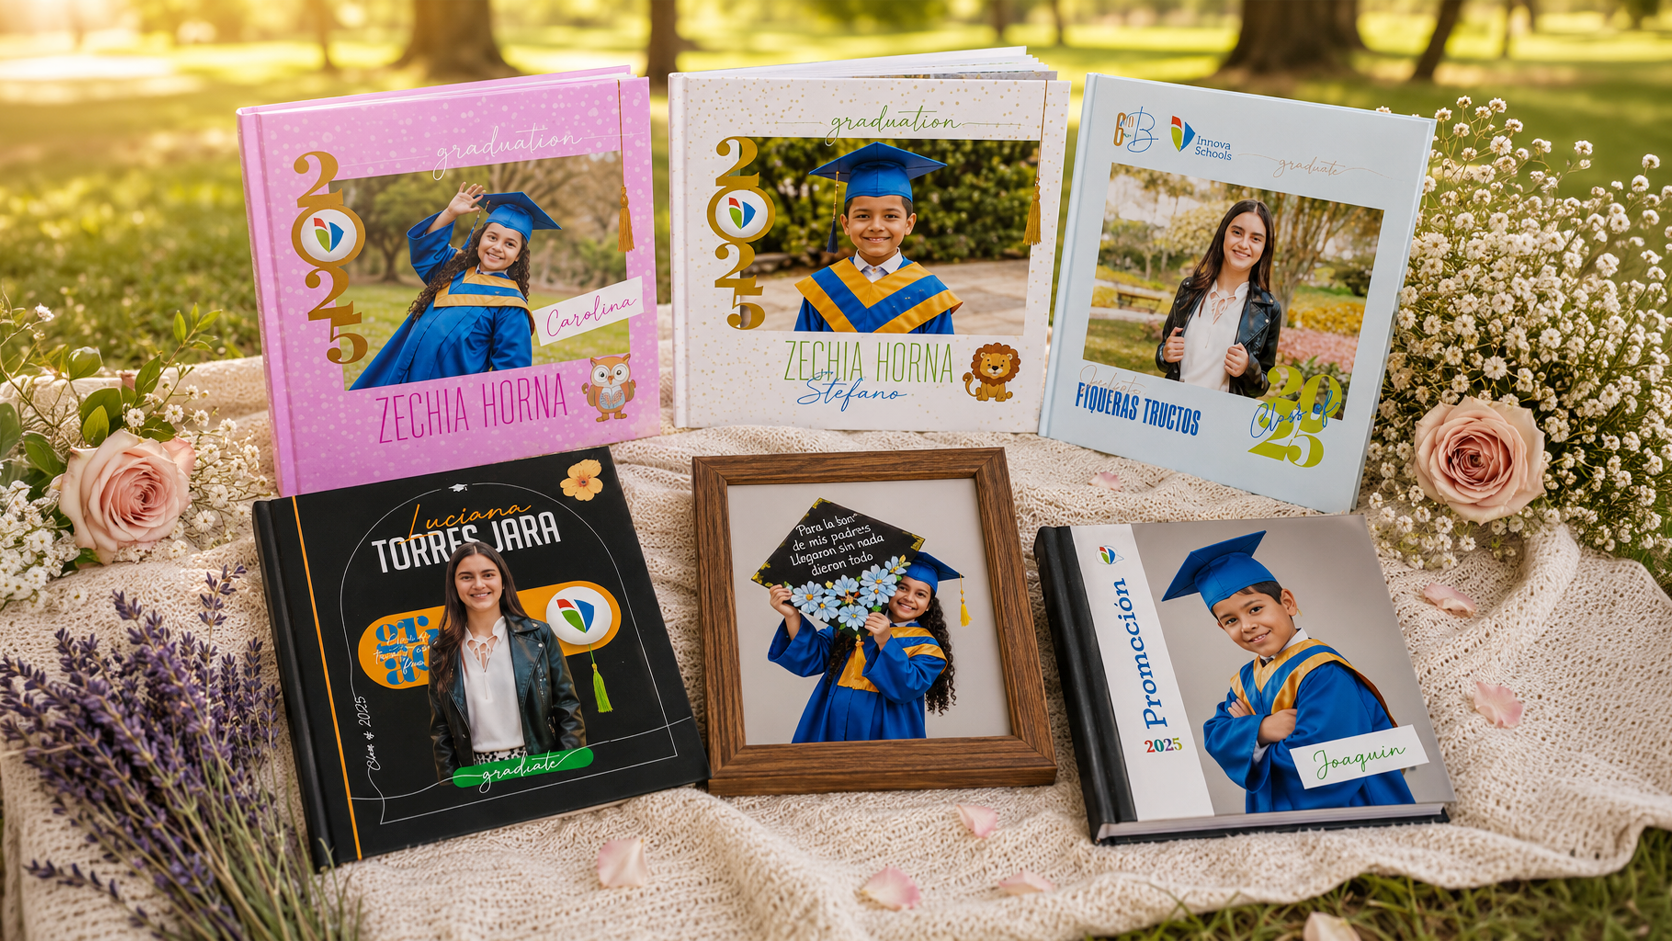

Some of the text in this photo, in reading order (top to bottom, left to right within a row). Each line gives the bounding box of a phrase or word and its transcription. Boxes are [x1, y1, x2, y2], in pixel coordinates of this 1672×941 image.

[825, 105, 961, 146] graduation
[1197, 135, 1231, 150] Innova
[433, 123, 582, 180] graduation
[1194, 146, 1232, 160] Schools
[1273, 156, 1346, 178] graduate
[546, 295, 637, 337] Carolina
[784, 341, 953, 383] ZECHIA HORNA
[375, 373, 568, 444] ZECHIA HORNA
[797, 370, 907, 412] Stefano
[1075, 382, 1201, 436] FIQUERAS TRUCTOS
[371, 511, 561, 573] TORRES JARA
[397, 504, 531, 545] Luciana
[792, 539, 806, 551] de
[809, 535, 828, 547] mis
[796, 524, 823, 536] Para
[823, 518, 835, 529] la
[857, 533, 884, 548] nada
[811, 551, 873, 576] dieron todo
[1114, 577, 1168, 729] Promcción
[354, 696, 371, 727] 2025
[1144, 737, 1182, 753] 2025
[1313, 745, 1406, 780] Joaquin
